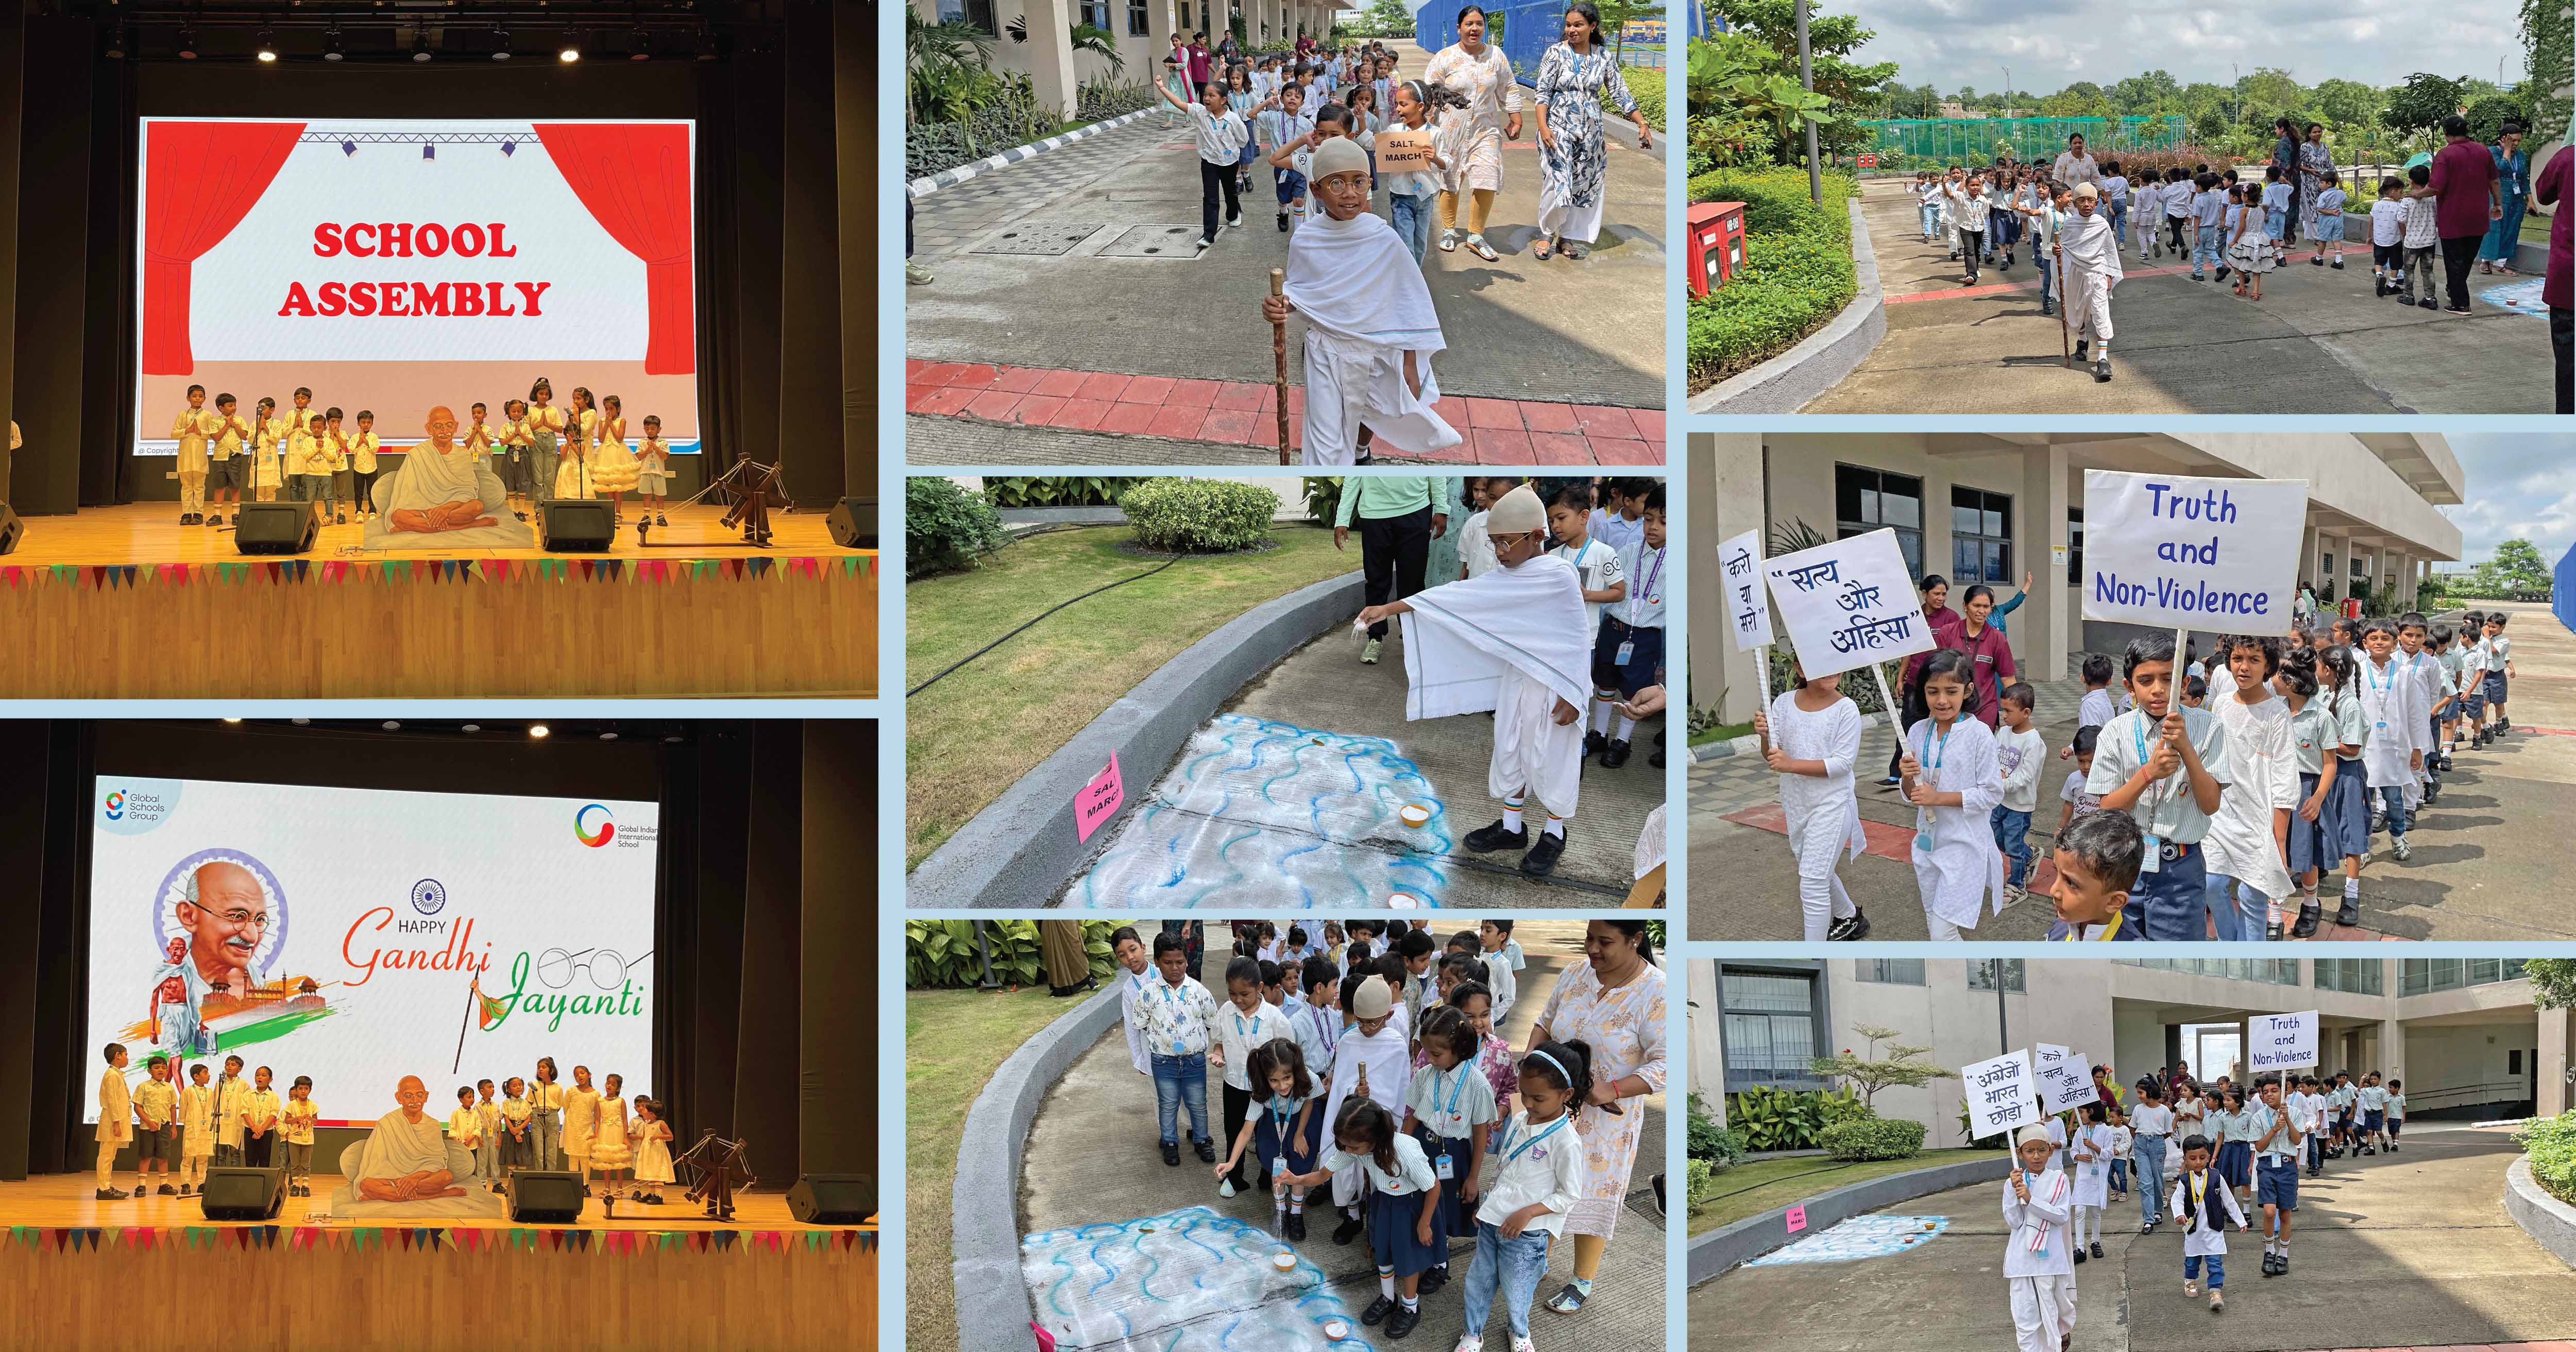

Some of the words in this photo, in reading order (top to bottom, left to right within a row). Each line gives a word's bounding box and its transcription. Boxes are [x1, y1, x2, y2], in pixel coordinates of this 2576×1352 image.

[1389, 140, 1414, 148] SALT
[1385, 152, 1421, 161] MARCH
[1726, 217, 1739, 232] HB-08
[313, 223, 517, 258] SCHOOL
[278, 281, 551, 317] ASSEMBLY
[146, 447, 179, 455] Copyright
[2145, 484, 2236, 524] Truth
[2158, 536, 2218, 566] and
[1739, 584, 1752, 604] या
[1836, 580, 1883, 611] और
[2096, 571, 2268, 614] Non-Violence
[130, 794, 159, 802] Global
[1087, 784, 1120, 819] MARCH
[130, 802, 165, 812] Schools
[129, 811, 158, 822] Group
[618, 825, 638, 833] Global
[399, 919, 447, 934] HAPPY
[342, 906, 493, 986] Gandhi
[482, 951, 644, 1033] Jayanti
[2269, 1016, 2300, 1030] Truth
[2275, 1033, 2295, 1046] and
[2253, 1050, 2312, 1065] Non-Violence
[2061, 1074, 2080, 1087] और
[1985, 1084, 2019, 1104] भारत
